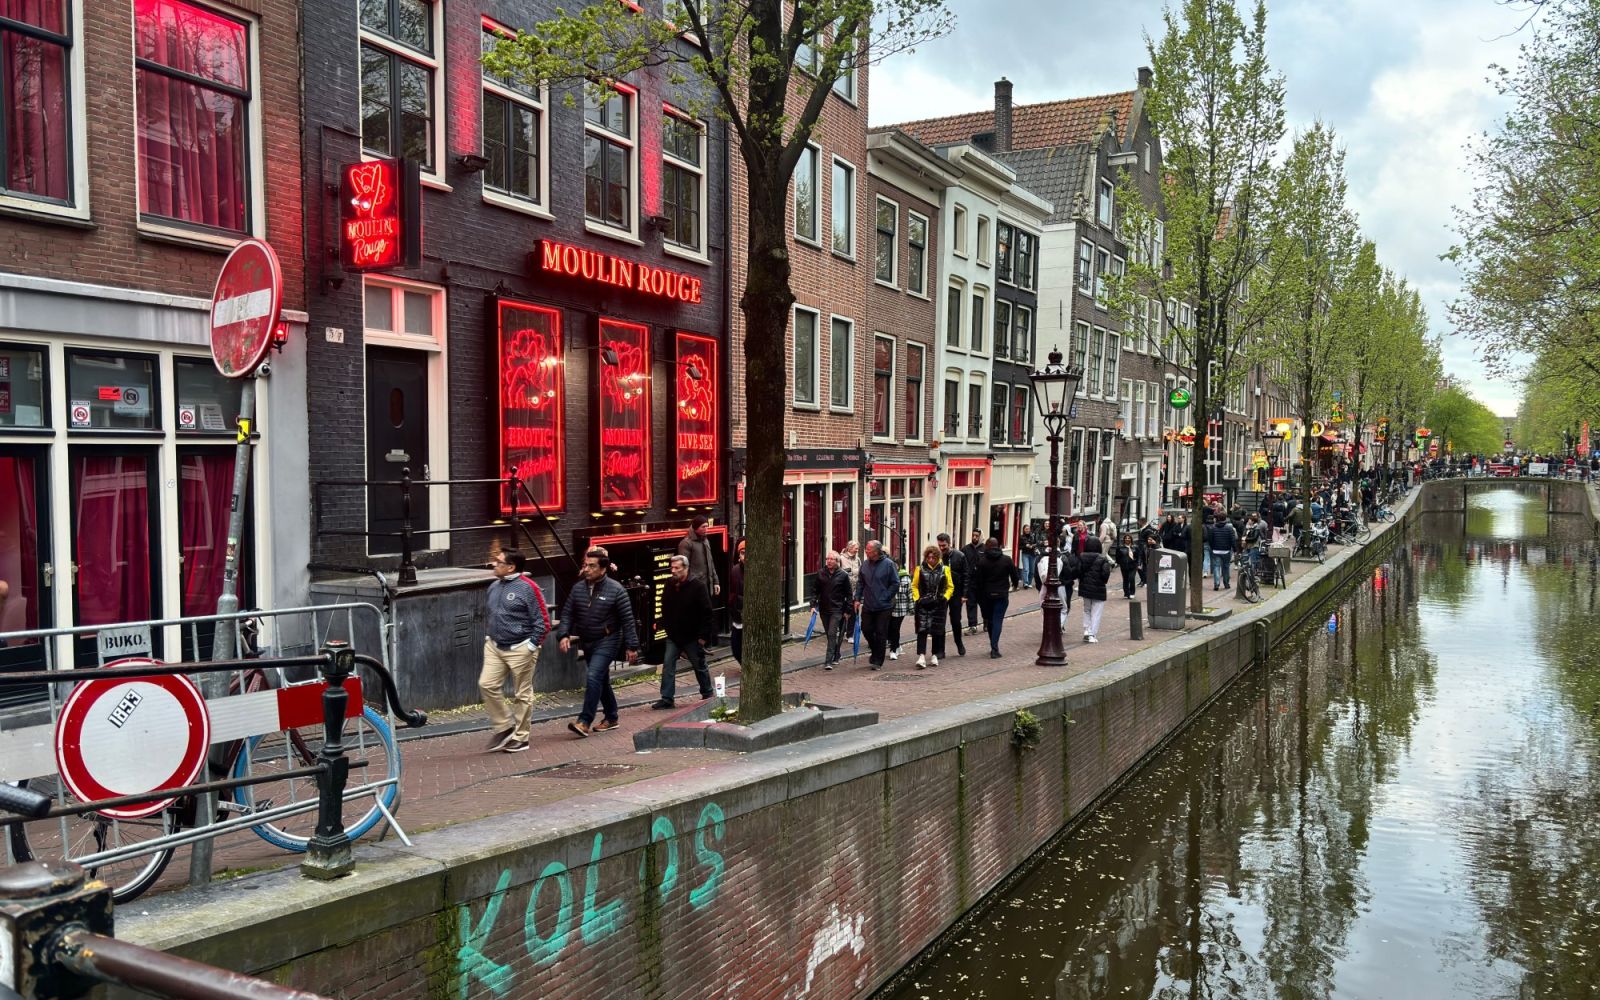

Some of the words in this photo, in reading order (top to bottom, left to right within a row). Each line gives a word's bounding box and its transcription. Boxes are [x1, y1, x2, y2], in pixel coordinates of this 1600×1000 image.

[347, 218, 395, 239] MOULIN
[353, 239, 389, 263] Rouge
[541, 240, 633, 288] MOULIN
[637, 264, 702, 303] ROUGE
[679, 432, 698, 450] LIVE
[699, 434, 714, 450] SEX
